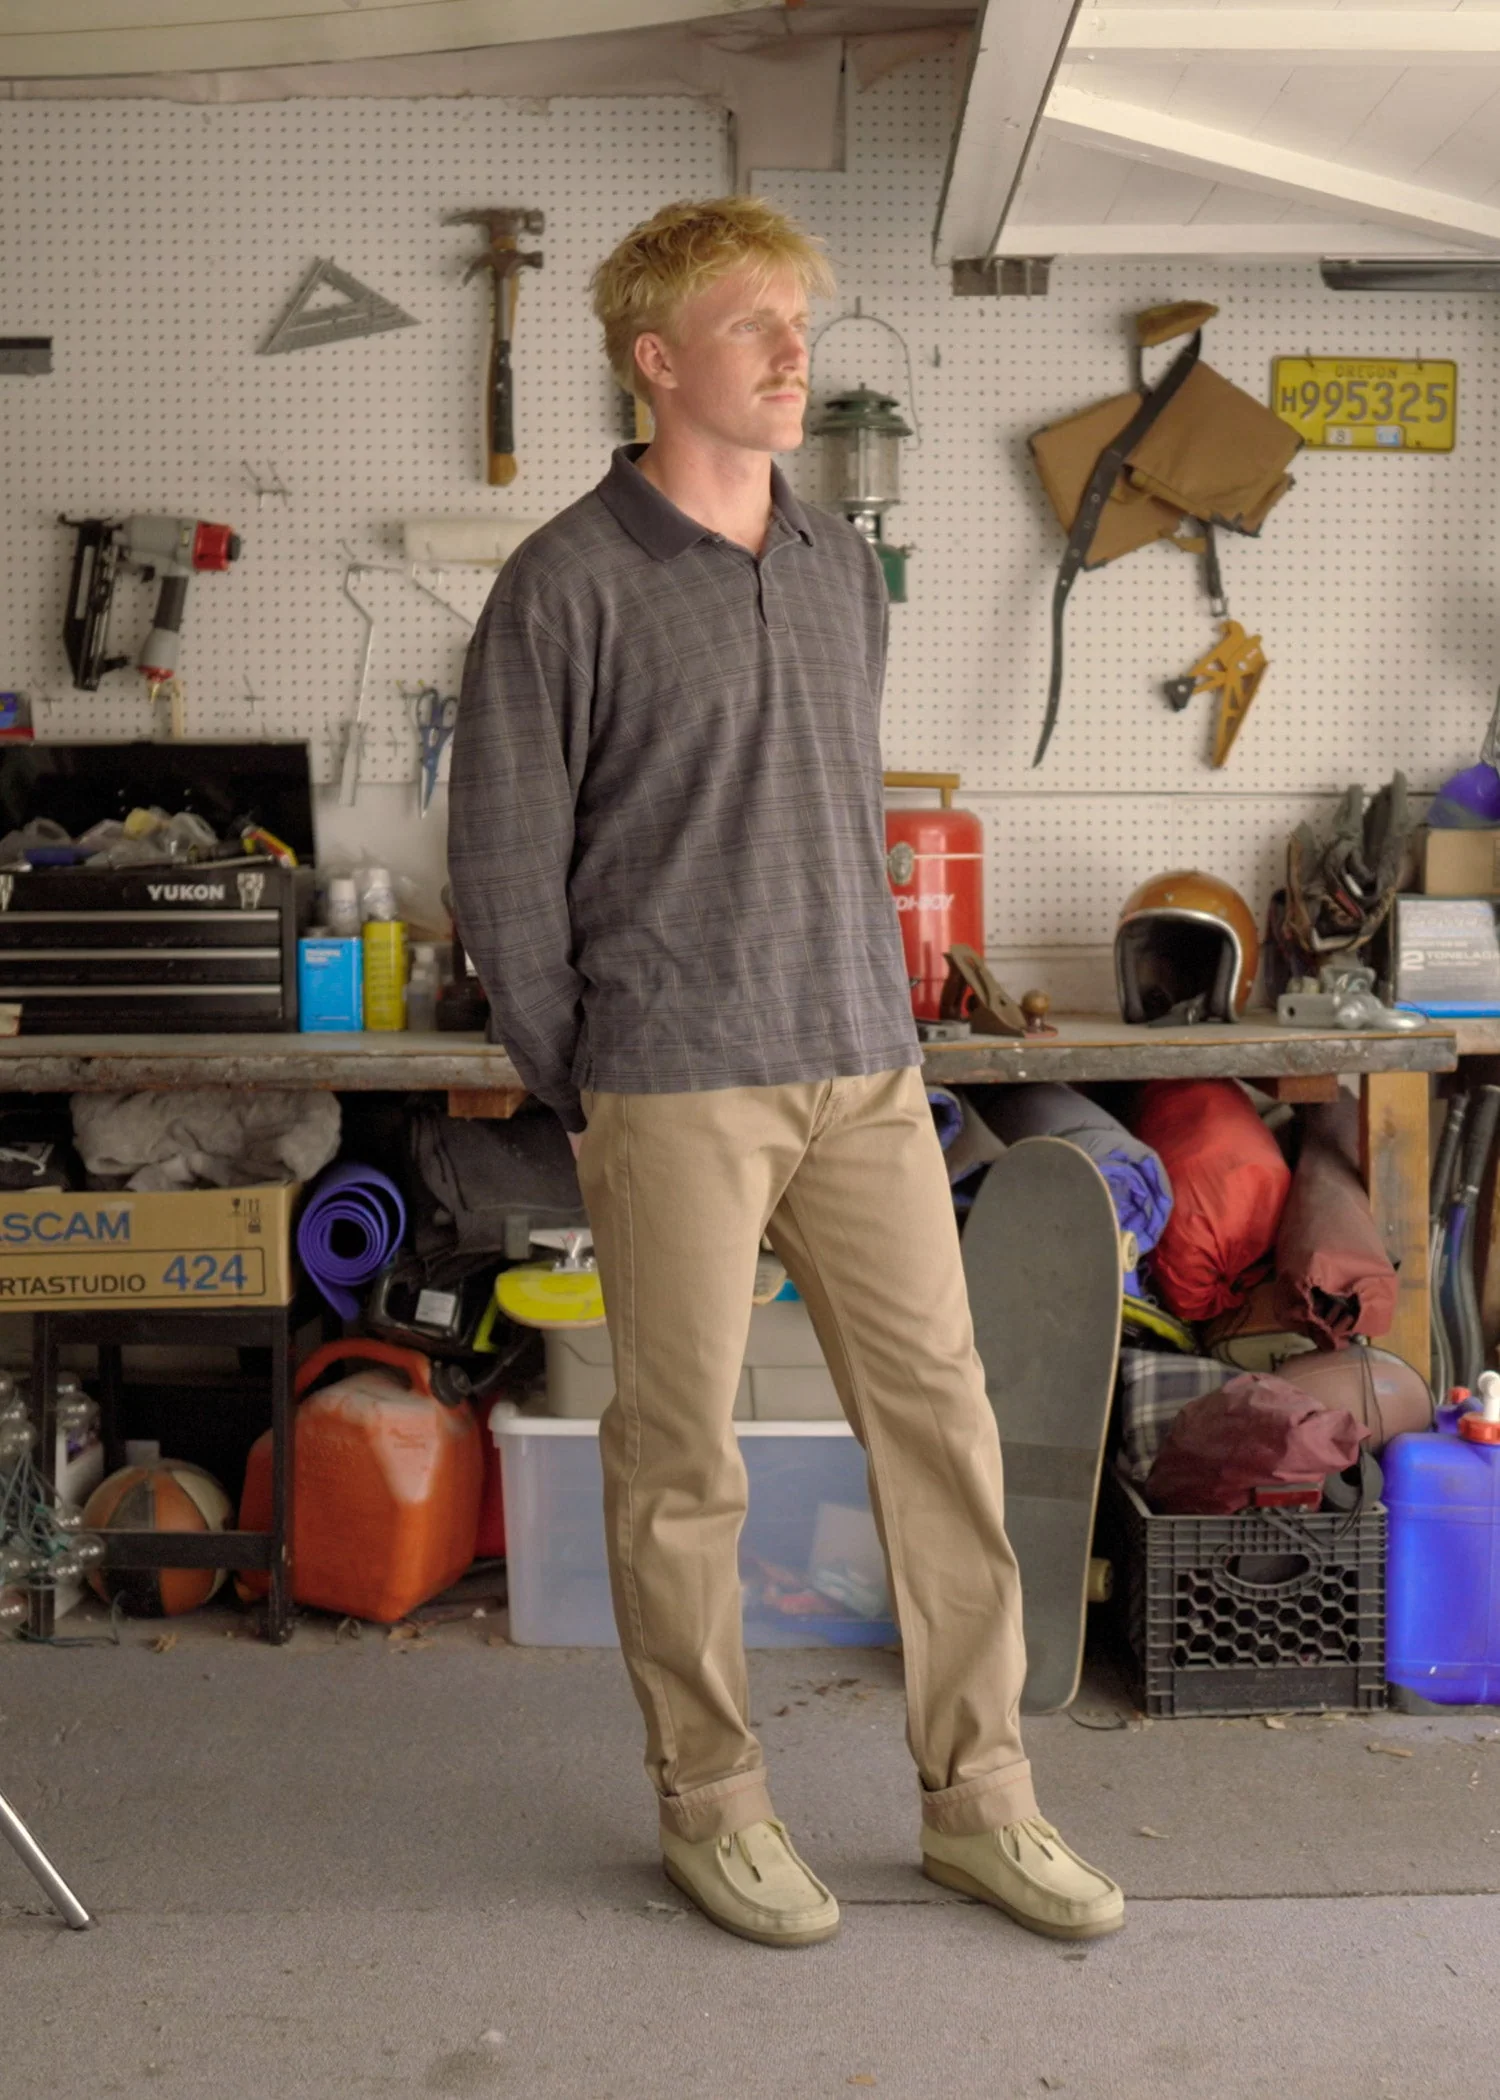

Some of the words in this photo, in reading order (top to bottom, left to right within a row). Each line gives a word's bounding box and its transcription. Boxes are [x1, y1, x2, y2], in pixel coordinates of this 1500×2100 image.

[1335, 365, 1398, 379] OREGON
[1281, 381, 1448, 423] H995325
[147, 884, 226, 902] YUKON
[1400, 950, 1425, 971] 2
[0, 1211, 132, 1242] SCAM
[162, 1254, 248, 1291] 424
